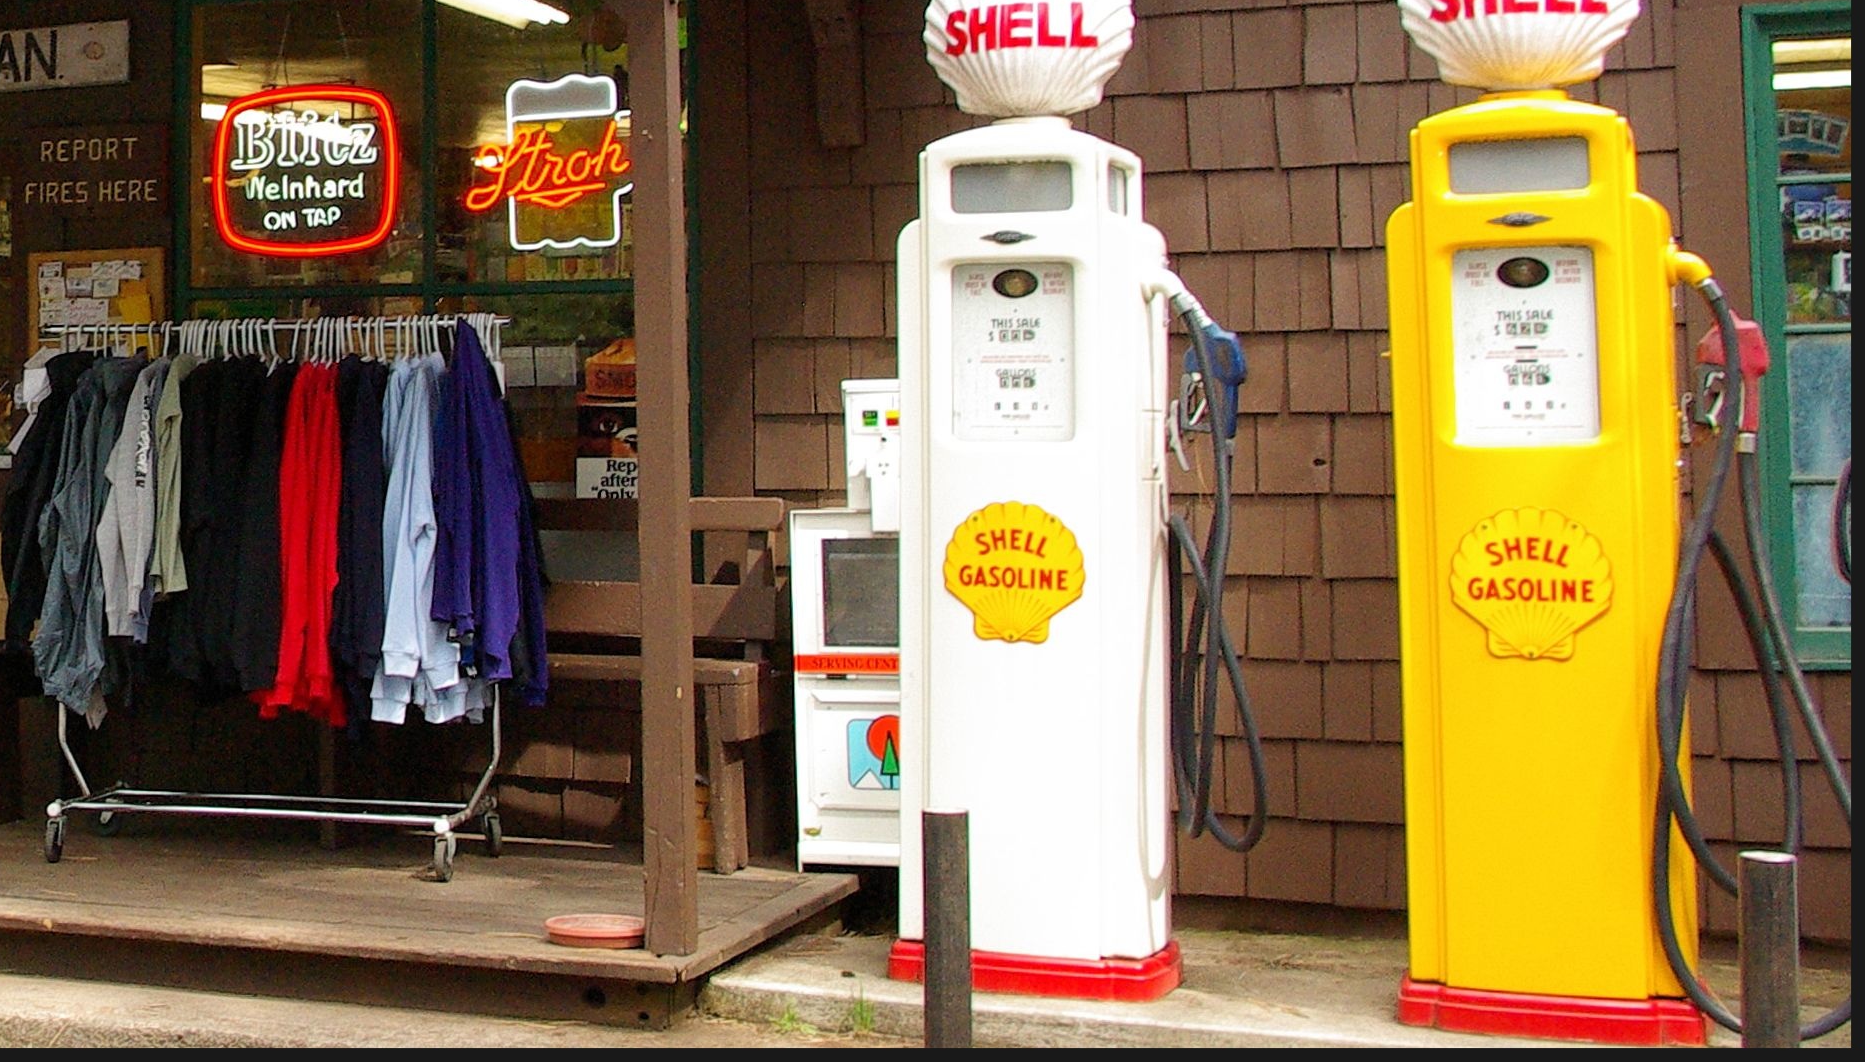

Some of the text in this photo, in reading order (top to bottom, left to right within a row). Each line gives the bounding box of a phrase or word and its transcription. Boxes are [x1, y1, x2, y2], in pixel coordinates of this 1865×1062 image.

[945, 1, 1099, 58] SHELL
[39, 136, 140, 163] REPORT
[229, 108, 378, 171] Blitz
[24, 179, 159, 204] FIRES HERE
[245, 171, 365, 201] Weinhard
[263, 205, 342, 231] ON TAP
[991, 317, 1042, 329] THIS SALE
[1496, 308, 1555, 322] THIS SALE
[600, 473, 639, 488] after
[606, 459, 638, 476] Rep
[974, 529, 1048, 559] SHELL
[1484, 536, 1569, 569] SHELL
[958, 564, 1069, 591] GASOLINE
[1467, 577, 1594, 603] GASOLINE
[813, 657, 863, 670] SERVING
